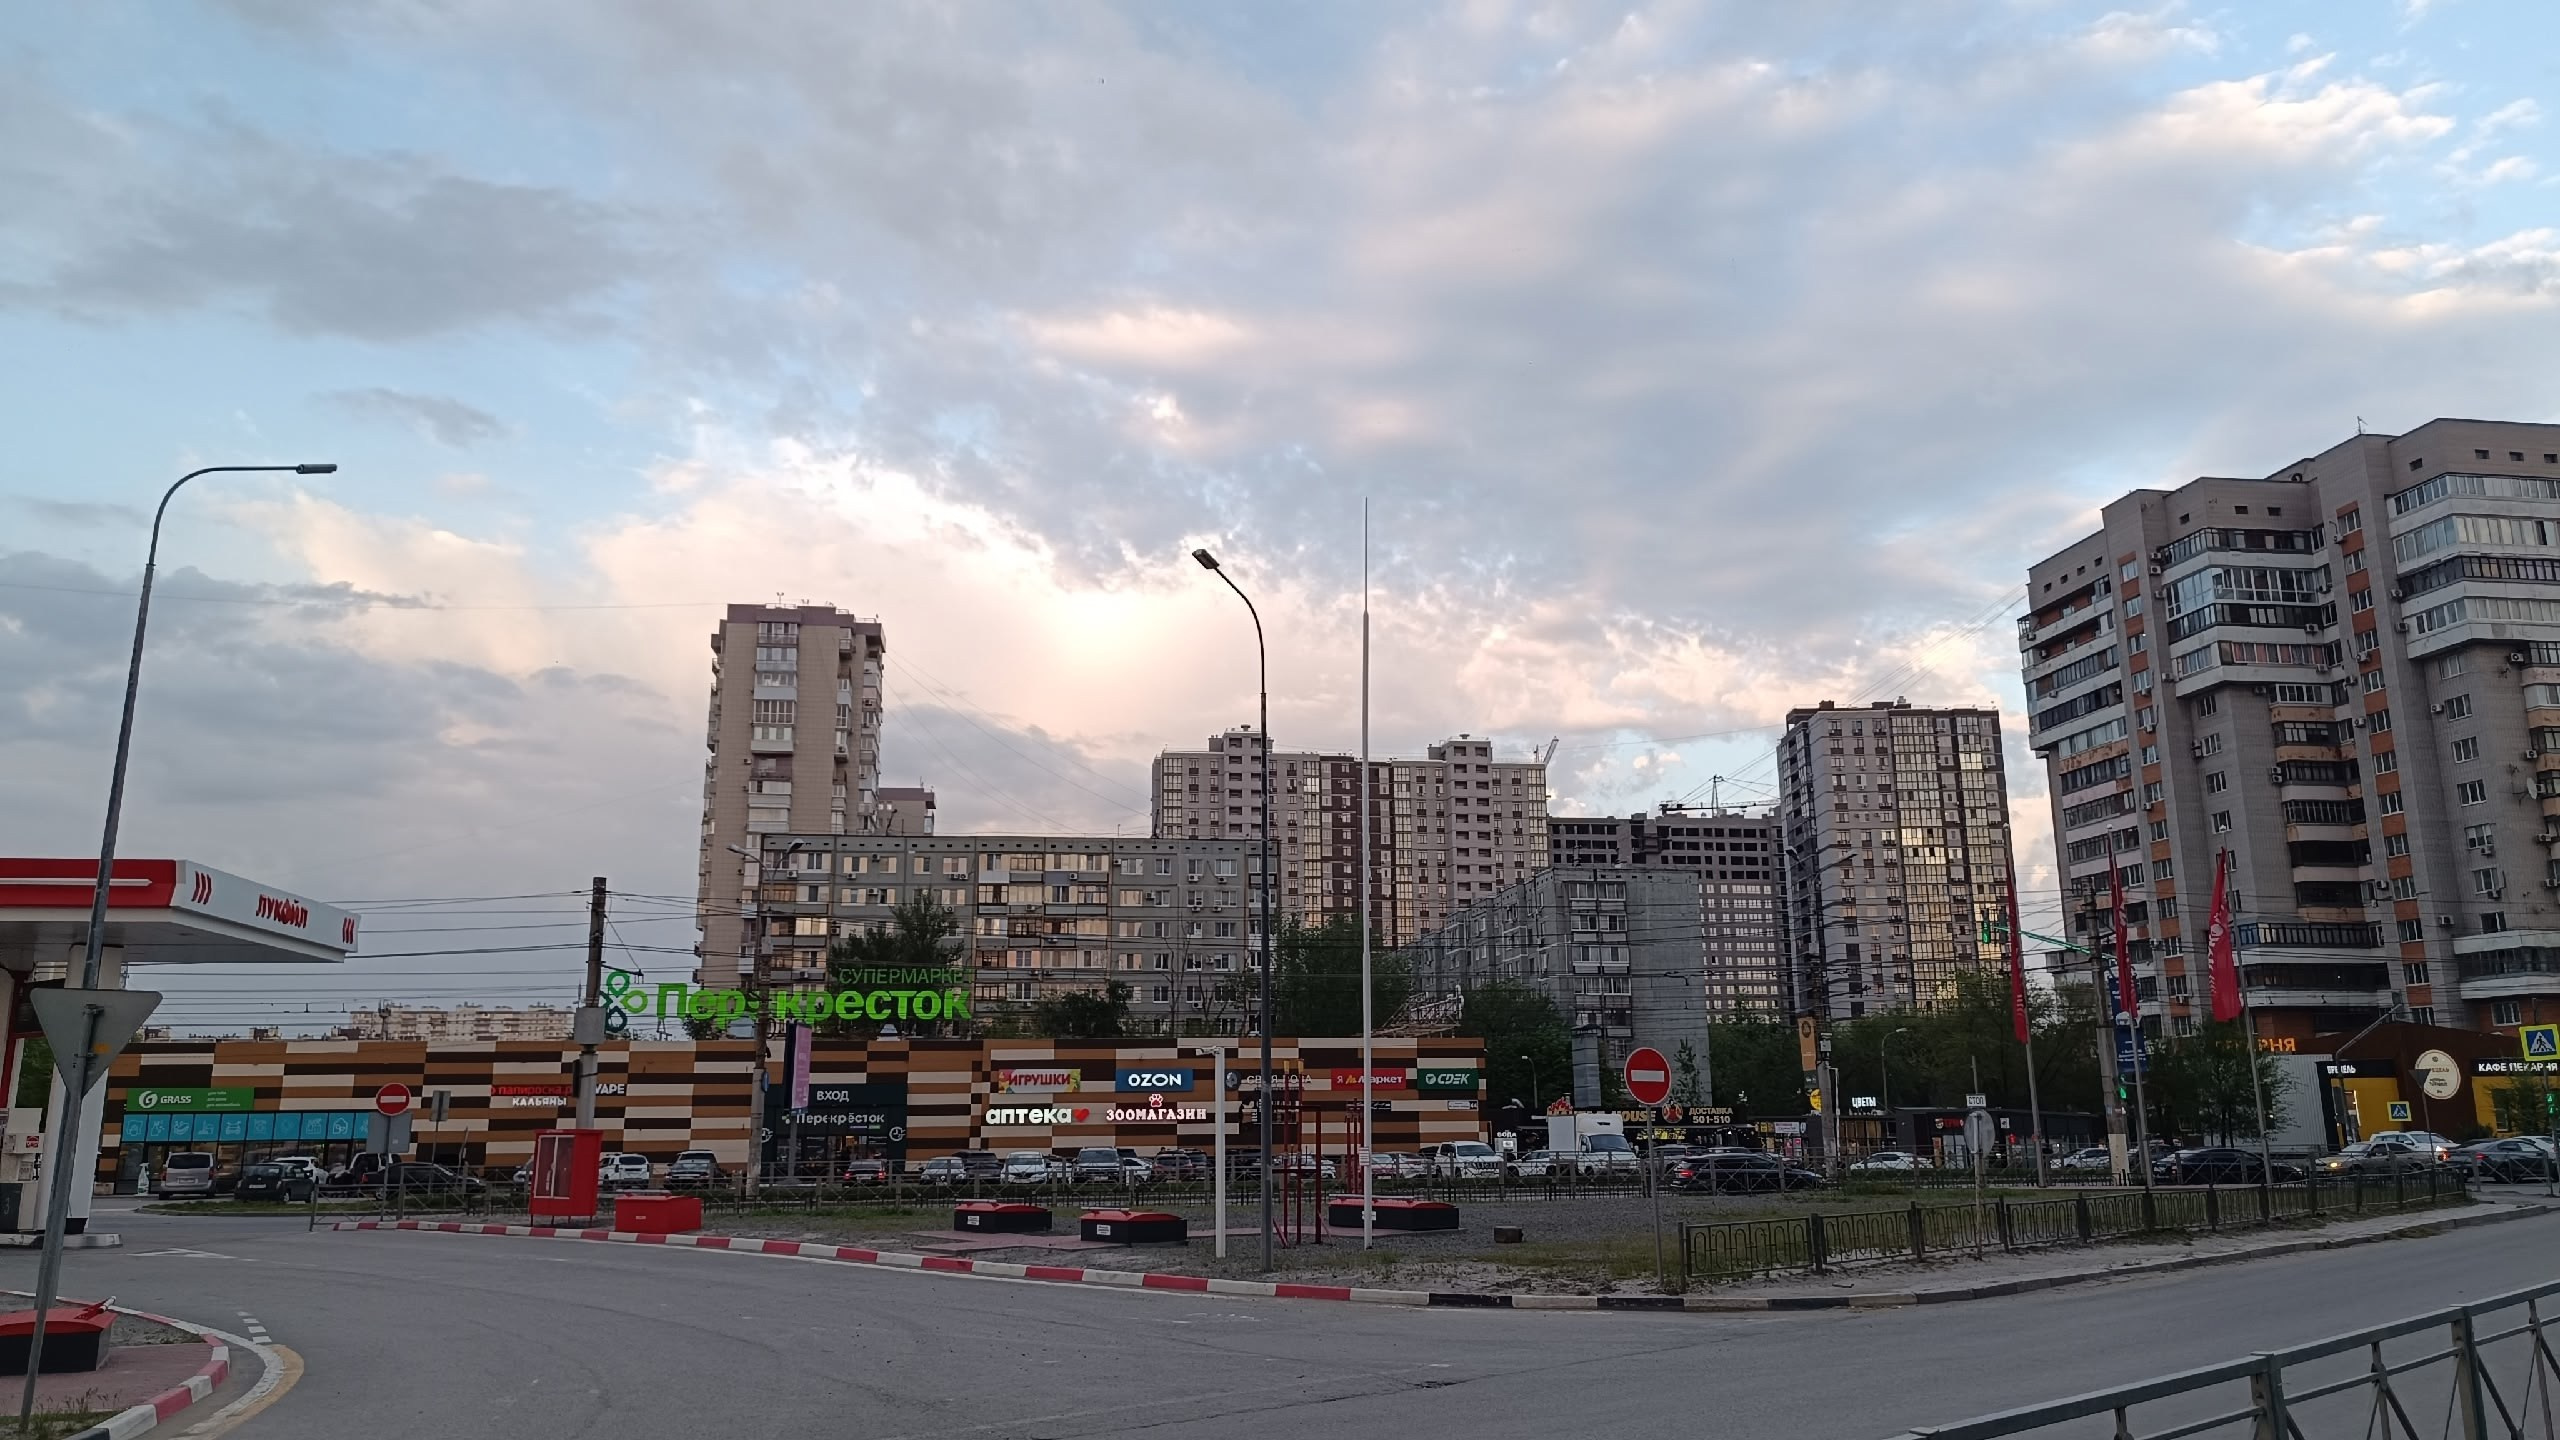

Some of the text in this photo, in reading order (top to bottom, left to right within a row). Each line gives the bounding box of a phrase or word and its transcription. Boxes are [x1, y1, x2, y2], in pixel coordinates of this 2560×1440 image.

[2478, 1062, 2508, 1072] КАФЕ
[1008, 1073, 1072, 1087] ИГРУШКИ
[1128, 1073, 1182, 1087] OZON
[1336, 1075, 1344, 1084] Я
[160, 1095, 192, 1104] GRASS
[512, 1097, 567, 1107] КАЛЬЯНЫ
[816, 1090, 850, 1103] ВХОД
[1851, 1096, 1877, 1108] ЦВЕТЫ
[985, 1107, 1072, 1125] аптека
[1106, 1108, 1208, 1121] ЗООМАГАЗИН
[1612, 1110, 1657, 1122] OUSE
[1688, 1107, 1734, 1116] ДОСТАВКА
[1692, 1115, 1731, 1124] 501-510
